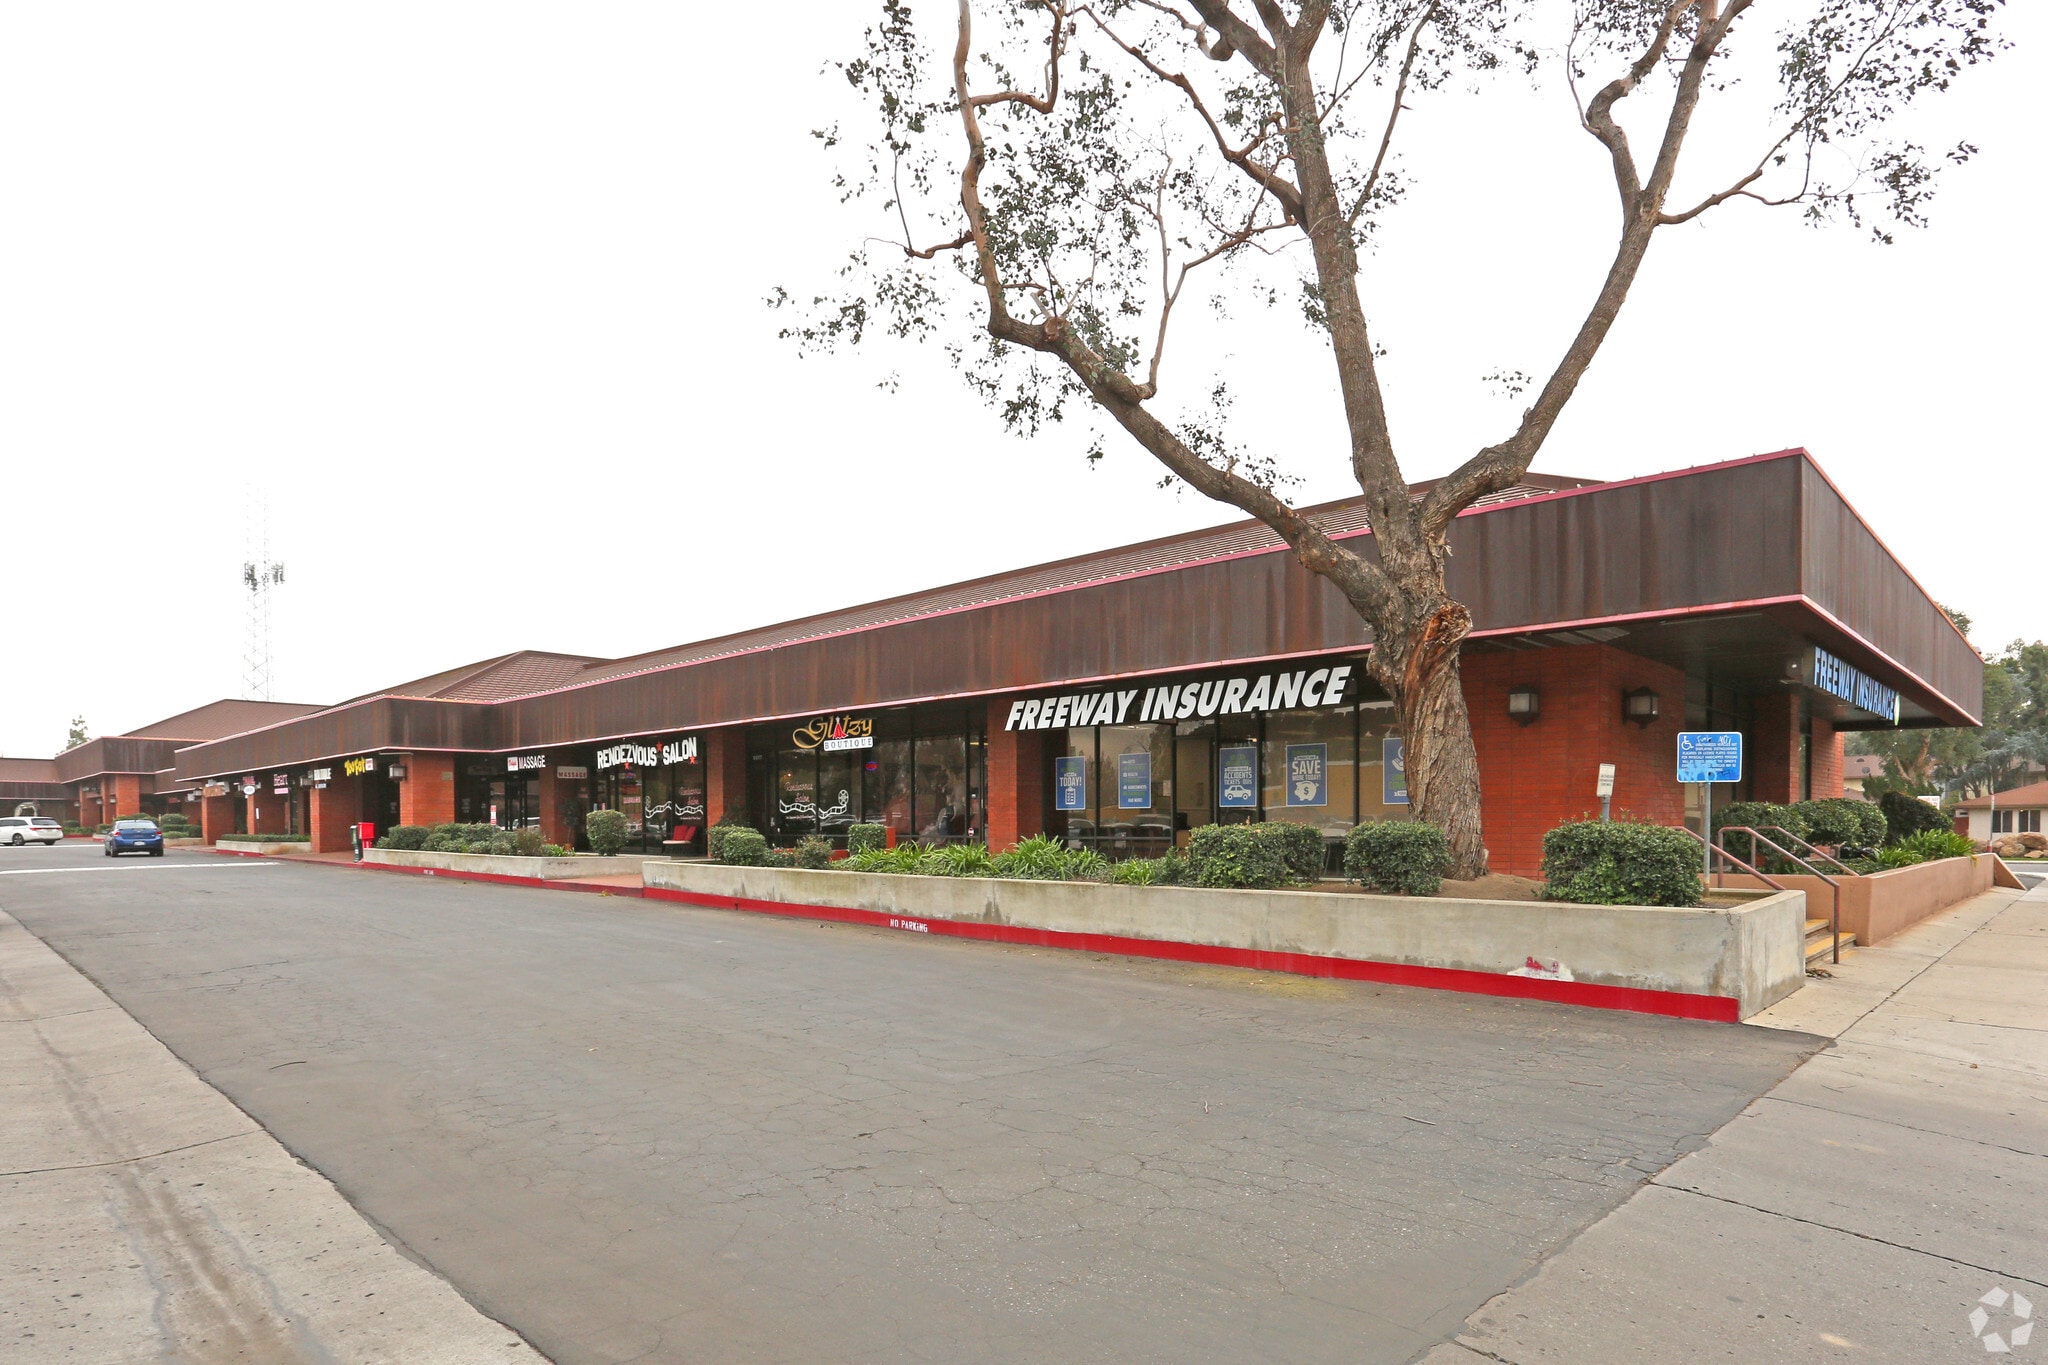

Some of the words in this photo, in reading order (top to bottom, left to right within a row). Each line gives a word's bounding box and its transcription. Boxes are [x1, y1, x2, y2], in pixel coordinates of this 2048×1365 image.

[1814, 646, 1857, 703] FREEWAY
[1856, 671, 1895, 721] INSURANCE
[1005, 689, 1138, 731] FREEWAY
[1139, 665, 1352, 722] INSURANCE
[824, 737, 872, 750] BOUTIQUE
[597, 744, 657, 769] RENDEZVOUS
[662, 736, 697, 766] SALON
[519, 755, 546, 769] MASSAGE
[1292, 759, 1321, 775] SAVE
[1060, 776, 1082, 787] TODAY!
[1224, 771, 1252, 779] ACCIDENTS
[889, 918, 899, 927] NO
